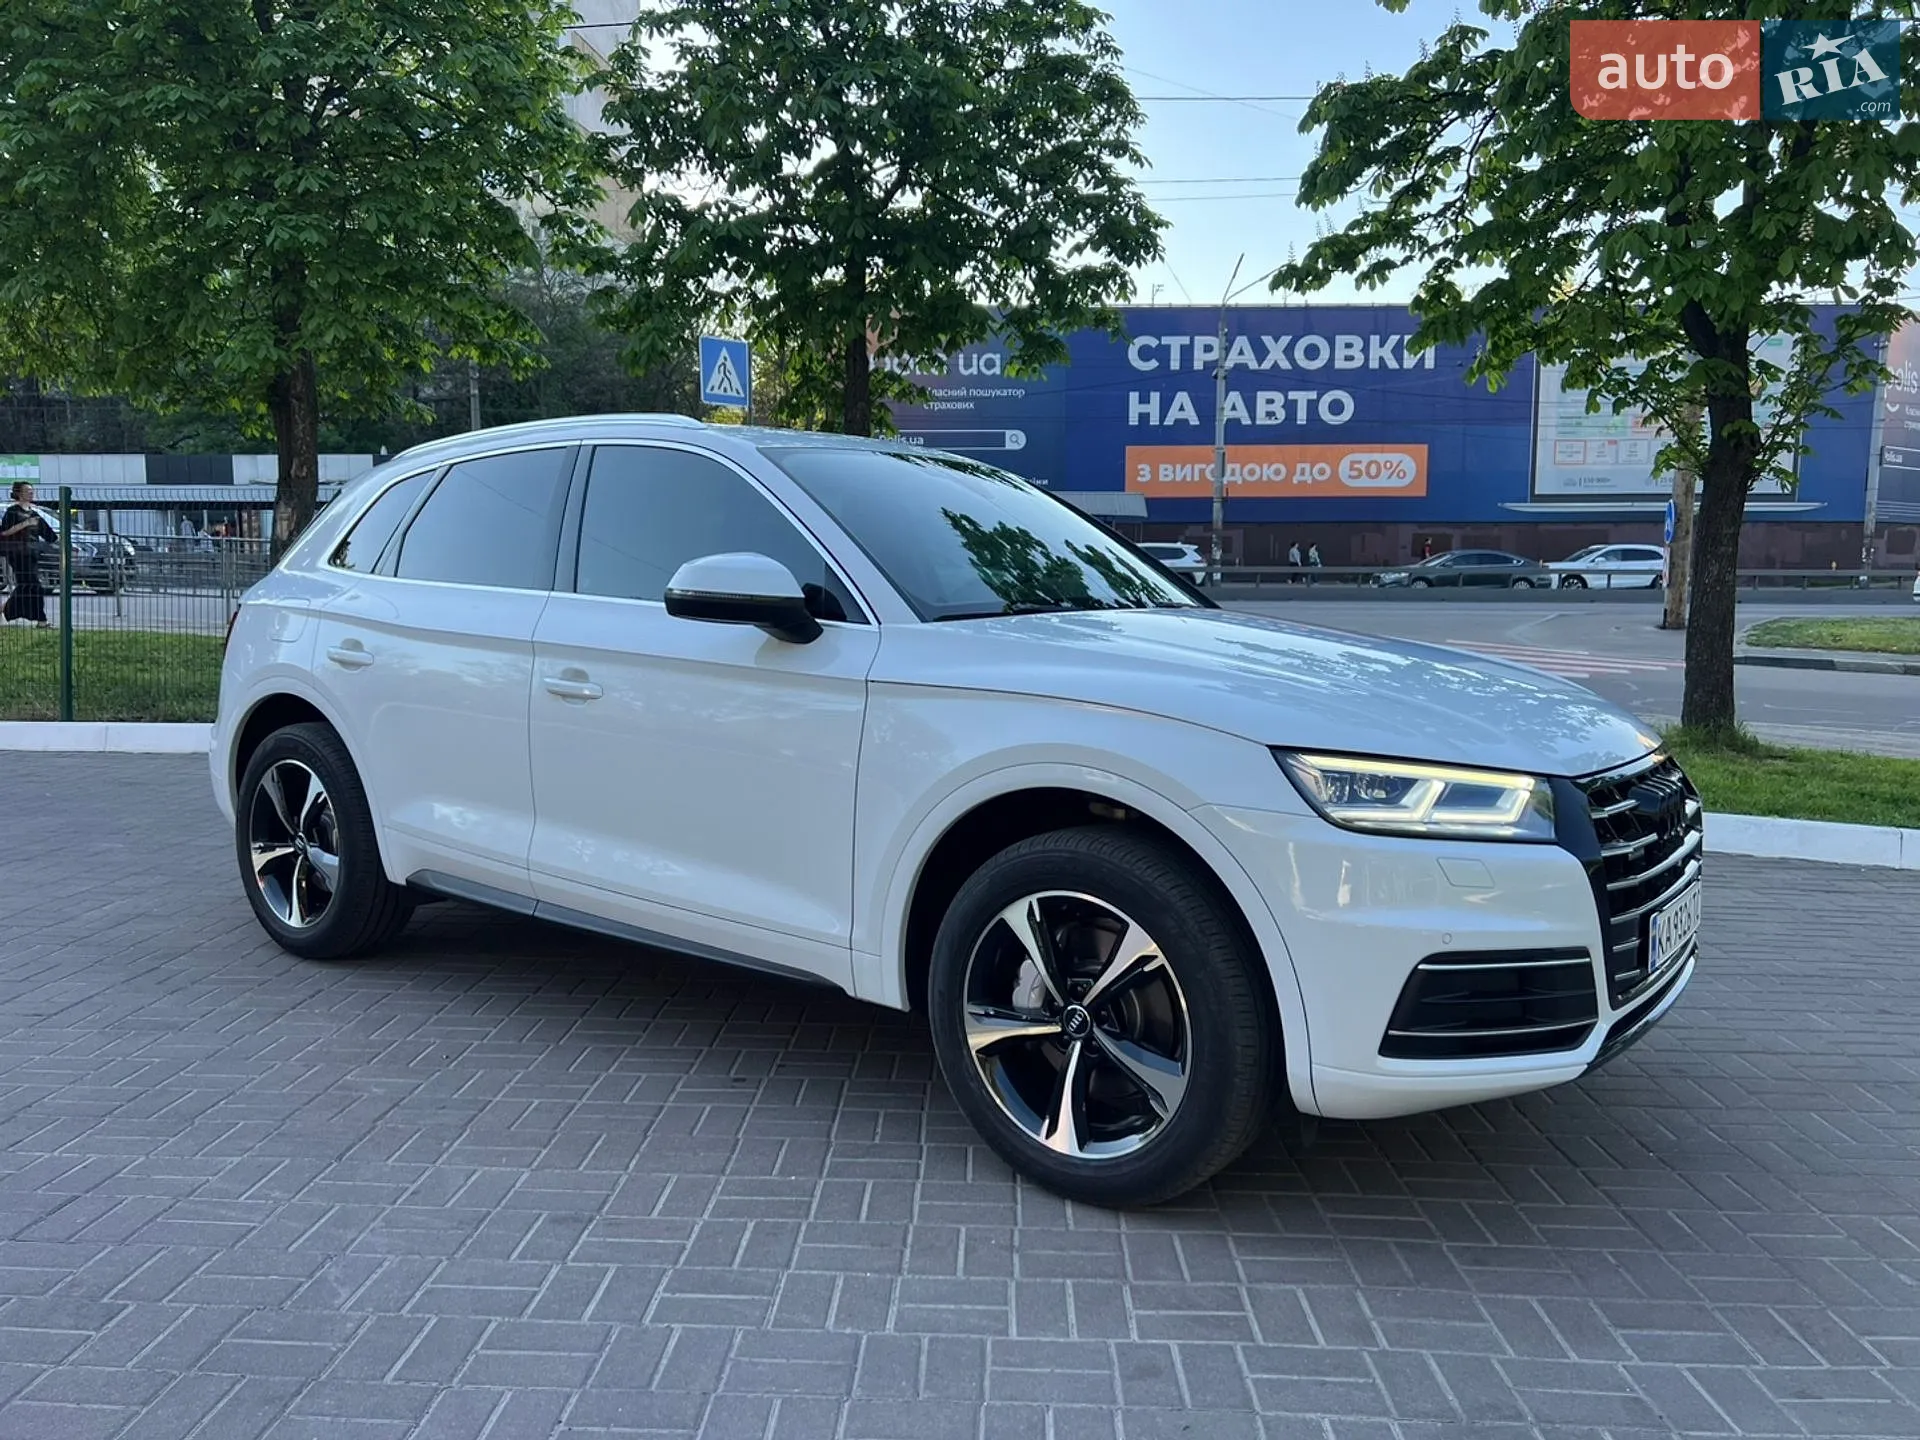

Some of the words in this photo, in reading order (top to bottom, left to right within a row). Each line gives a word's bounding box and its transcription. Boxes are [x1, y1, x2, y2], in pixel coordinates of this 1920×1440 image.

[1127, 334, 1436, 371] СТРАХОВКИ
[1128, 391, 1200, 426] НА
[1221, 389, 1355, 426] АВТО
[1347, 459, 1407, 480] 50%
